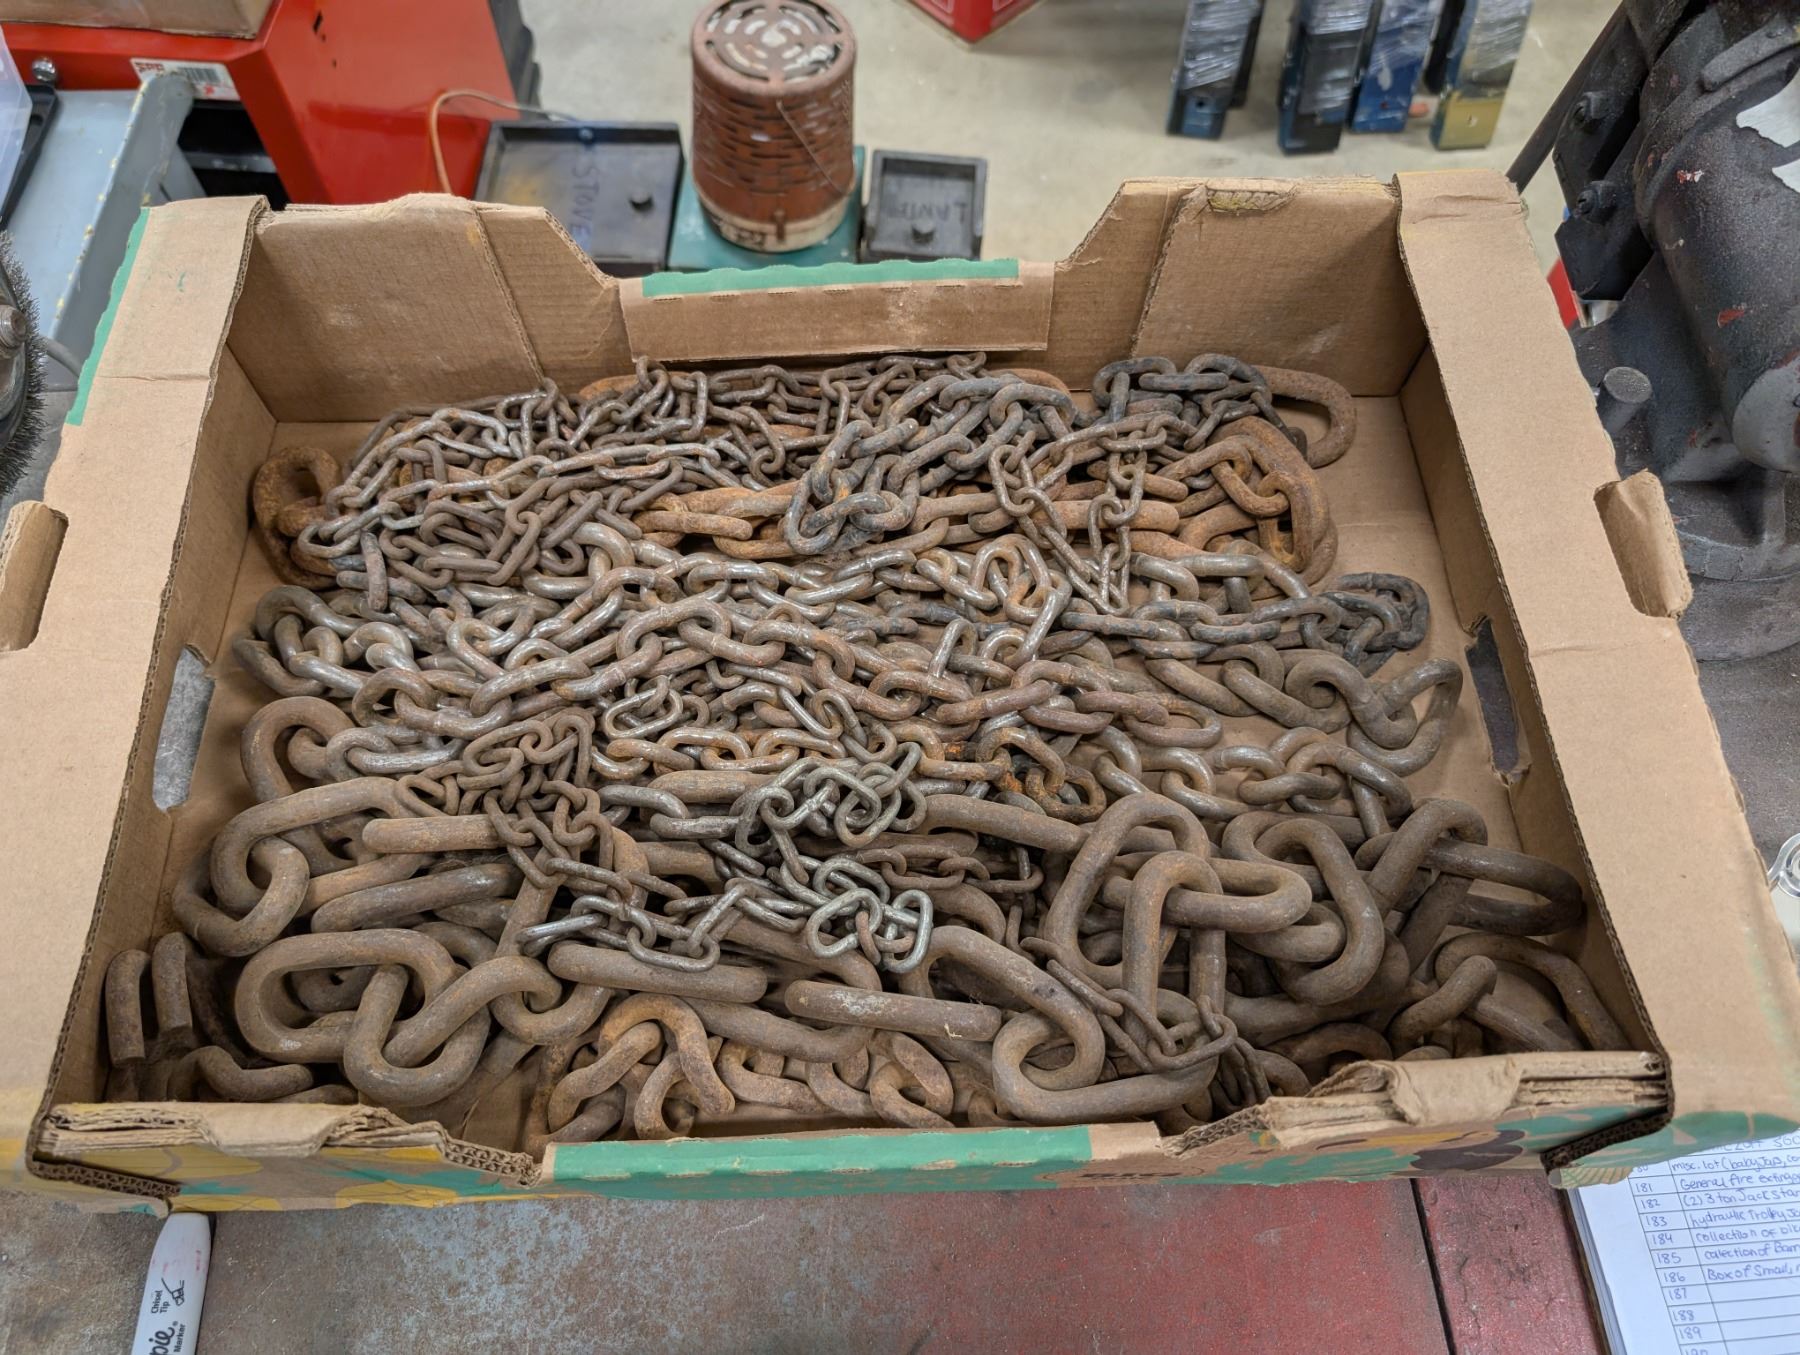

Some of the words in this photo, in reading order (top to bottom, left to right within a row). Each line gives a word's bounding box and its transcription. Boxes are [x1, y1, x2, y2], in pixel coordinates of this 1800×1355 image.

[1635, 1182, 1653, 1193] 181
[1680, 1178, 1730, 1191] General
[1640, 1198, 1661, 1209] 182
[1683, 1194, 1703, 1207] (2)
[1704, 1193, 1715, 1204] 3
[1645, 1215, 1668, 1227] 183
[1652, 1232, 1674, 1245] 184
[1656, 1252, 1682, 1264] 185
[1664, 1272, 1686, 1283] 186
[1707, 1267, 1734, 1281] Box
[1735, 1264, 1752, 1278] of
[1668, 1287, 1688, 1301] 187
[151, 1290, 163, 1314] Chisel
[159, 1301, 171, 1314] Tip
[1673, 1309, 1695, 1322] 188
[173, 1323, 186, 1353] Marker
[1679, 1326, 1702, 1339] 189
